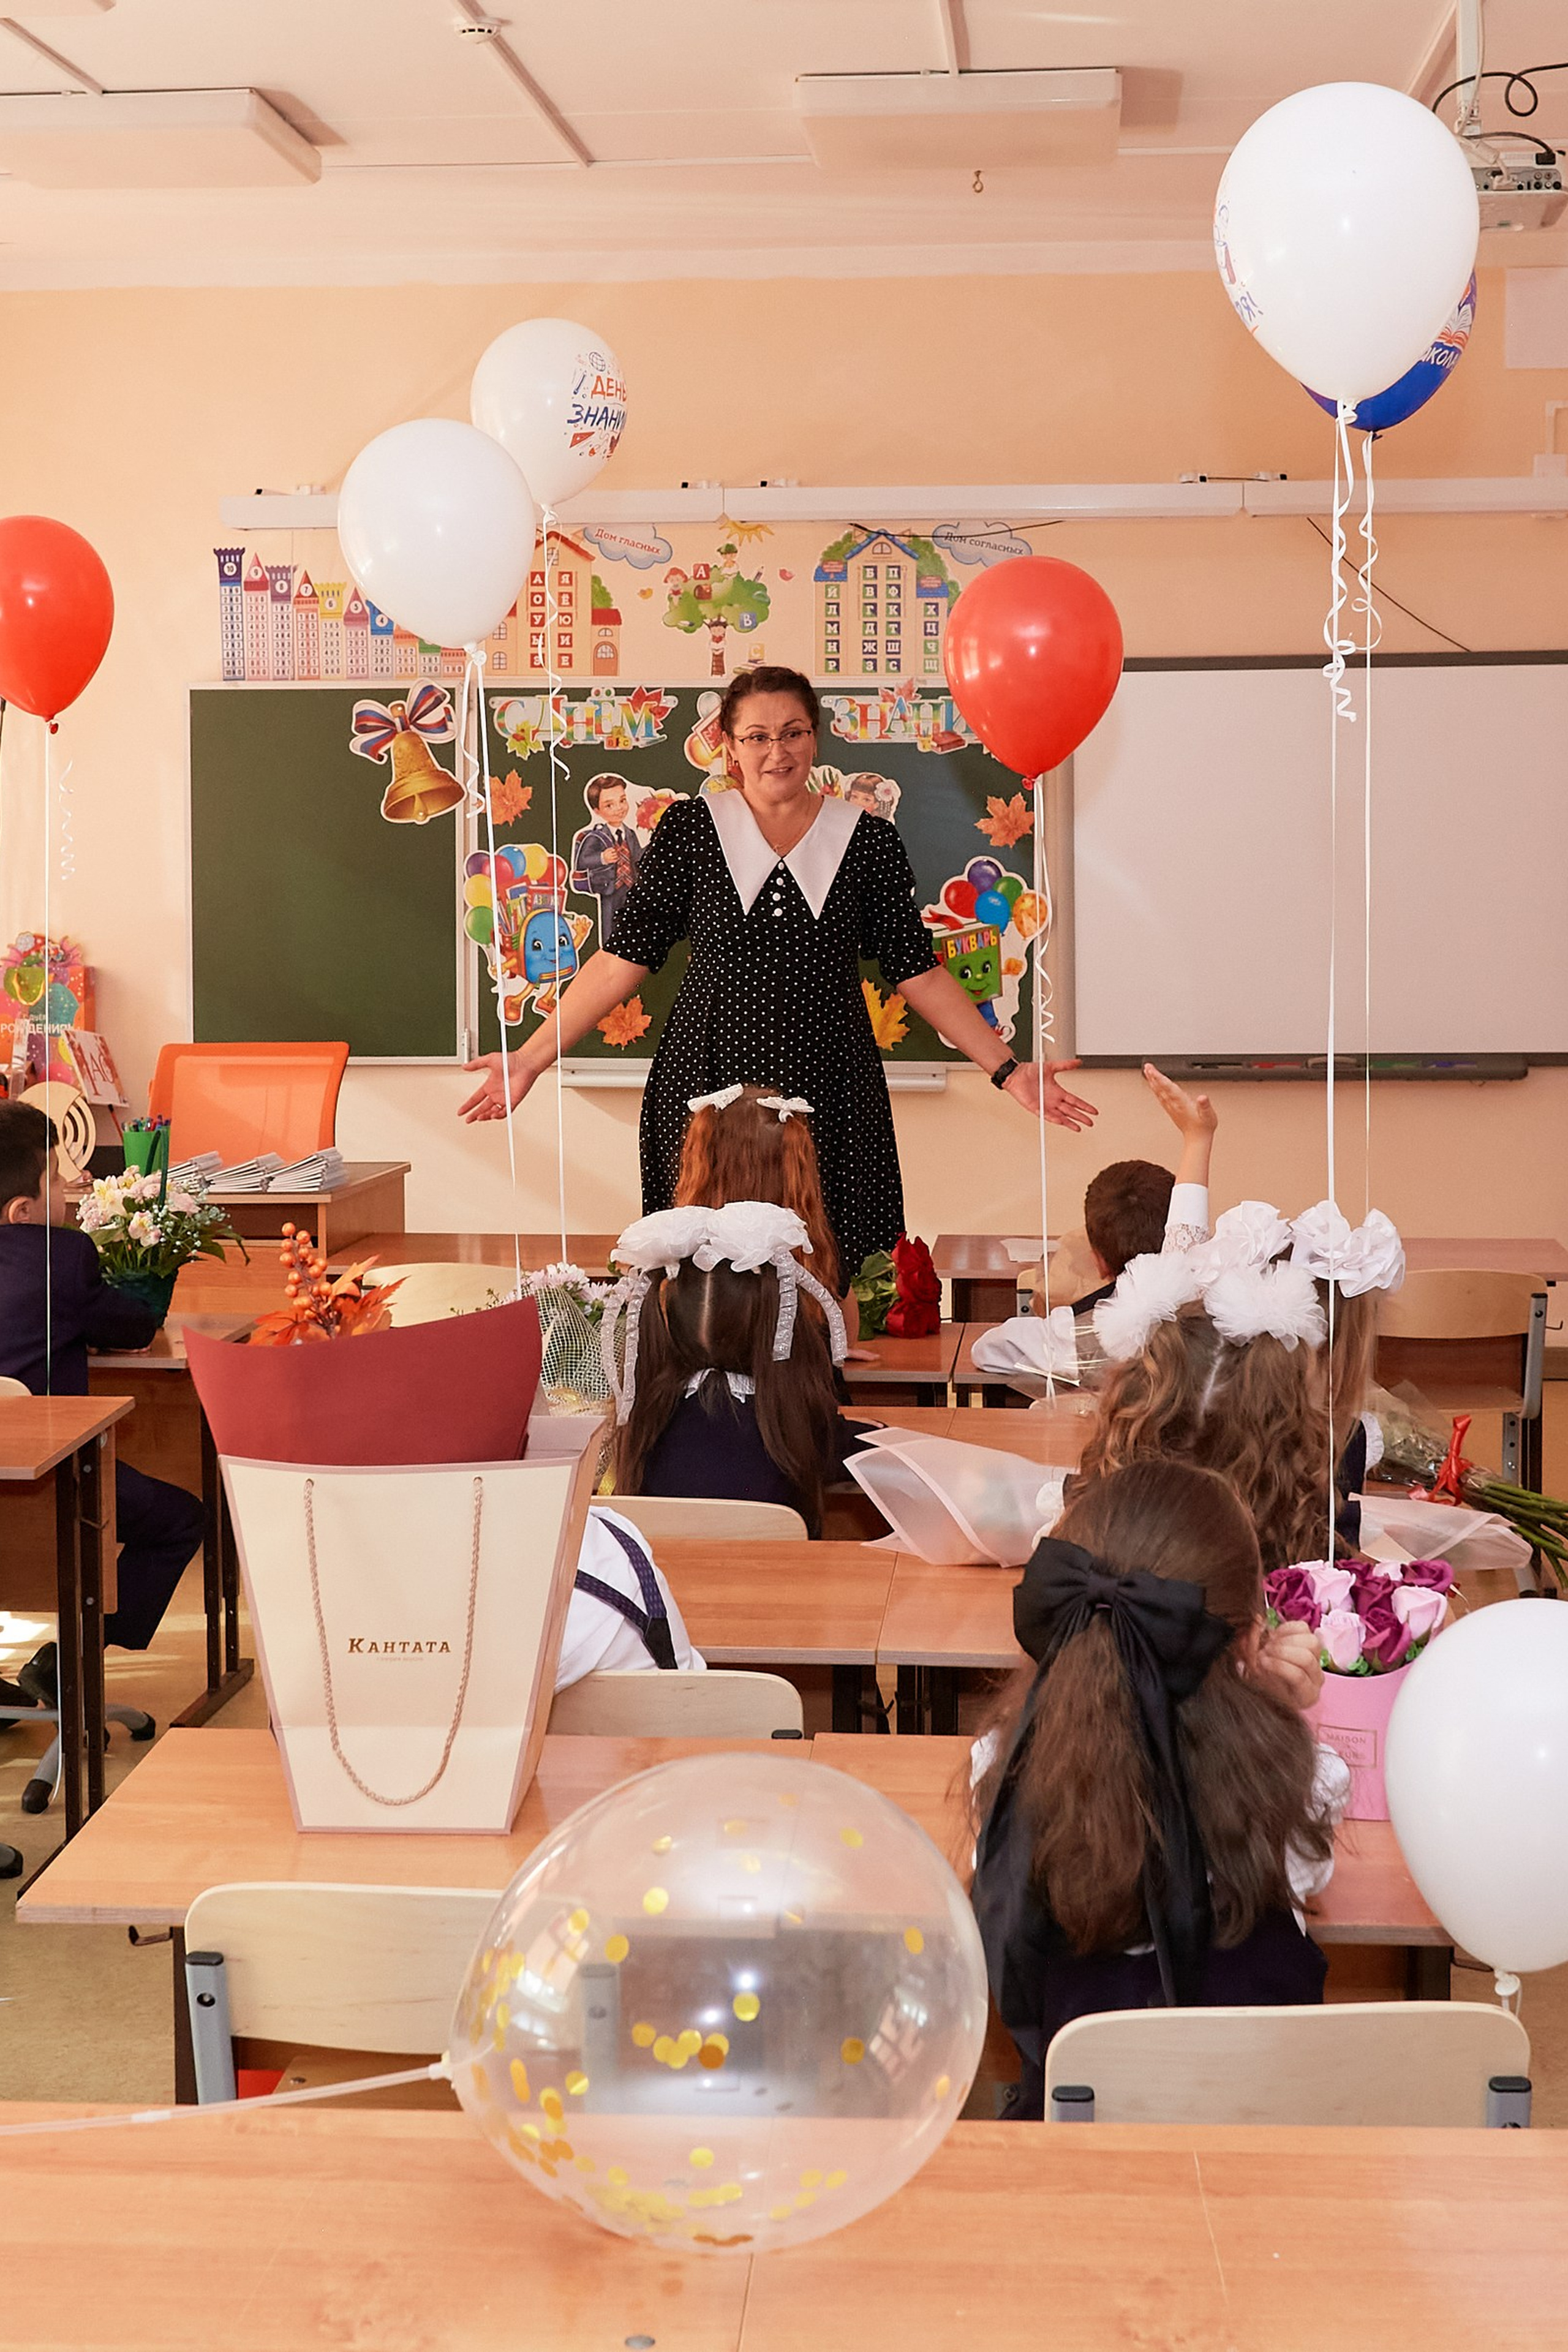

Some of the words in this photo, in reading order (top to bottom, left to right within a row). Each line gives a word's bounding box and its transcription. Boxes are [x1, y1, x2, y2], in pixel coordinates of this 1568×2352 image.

[590, 375, 627, 402] ДЕНЬ
[567, 403, 627, 431] ЗНАНИ
[594, 528, 617, 546] Дом
[619, 535, 661, 555] гласных
[943, 530, 967, 544] Дом
[968, 537, 1024, 555] согласных
[696, 566, 706, 578] A
[866, 568, 874, 578] Б
[888, 568, 898, 577] П
[533, 574, 542, 583] А
[561, 574, 569, 583] Я
[827, 586, 837, 597] Й
[865, 587, 874, 596] В
[533, 595, 541, 604] О
[866, 605, 873, 614] Г
[889, 605, 897, 614] К
[927, 605, 935, 614] Х
[533, 615, 541, 624] У
[559, 615, 571, 624] Ю
[827, 624, 837, 633] М
[865, 623, 874, 634] Д
[889, 624, 897, 633] Т
[560, 635, 570, 644] И
[827, 642, 837, 651] Н
[864, 643, 876, 652] Ж
[887, 643, 899, 652] Ш
[562, 656, 568, 665] Е
[828, 661, 836, 669] Р
[865, 661, 873, 670] З
[889, 661, 897, 670] С
[497, 699, 525, 734] С
[530, 689, 658, 742] ДНЁМ
[834, 696, 974, 740] ЗНАНИ
[947, 929, 997, 958] БУКВАРЬ
[1327, 1733, 1366, 1744] MAISON
